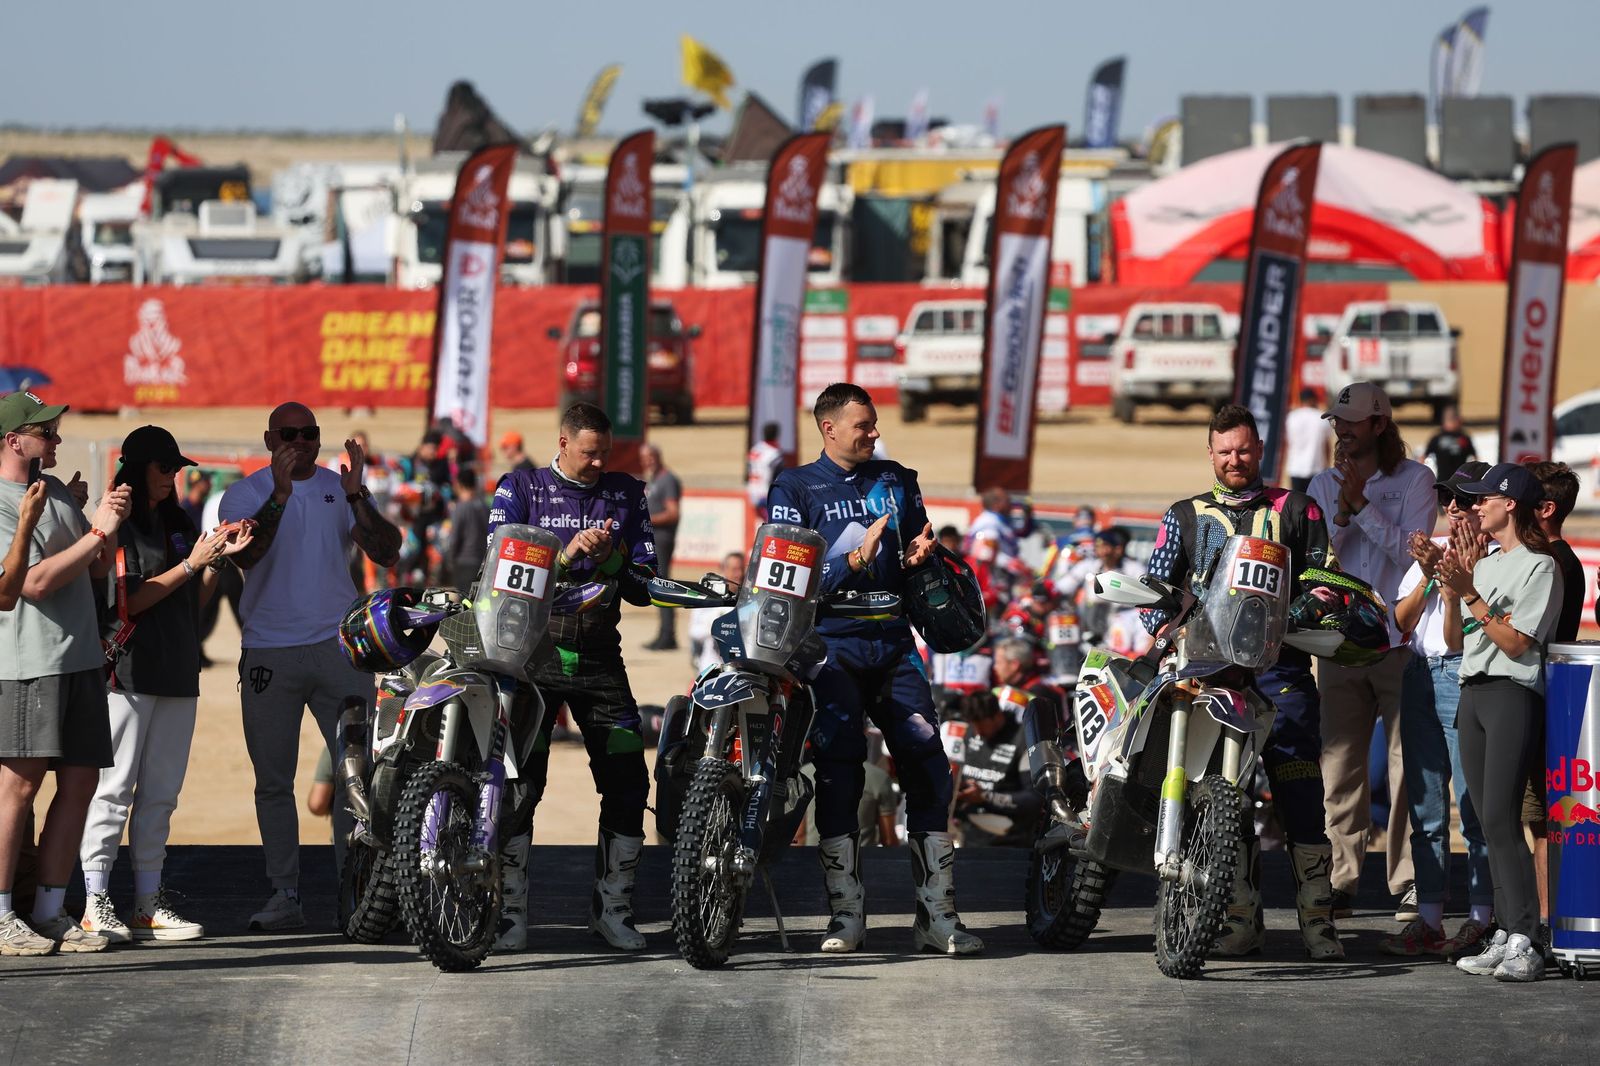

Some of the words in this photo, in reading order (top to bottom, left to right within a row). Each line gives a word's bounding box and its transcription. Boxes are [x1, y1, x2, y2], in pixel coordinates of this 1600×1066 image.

[456, 286, 480, 398] TUDOR
[321, 364, 391, 390] LIVE
[507, 564, 536, 594] 81
[768, 561, 796, 591] 91
[1238, 561, 1280, 594] 103
